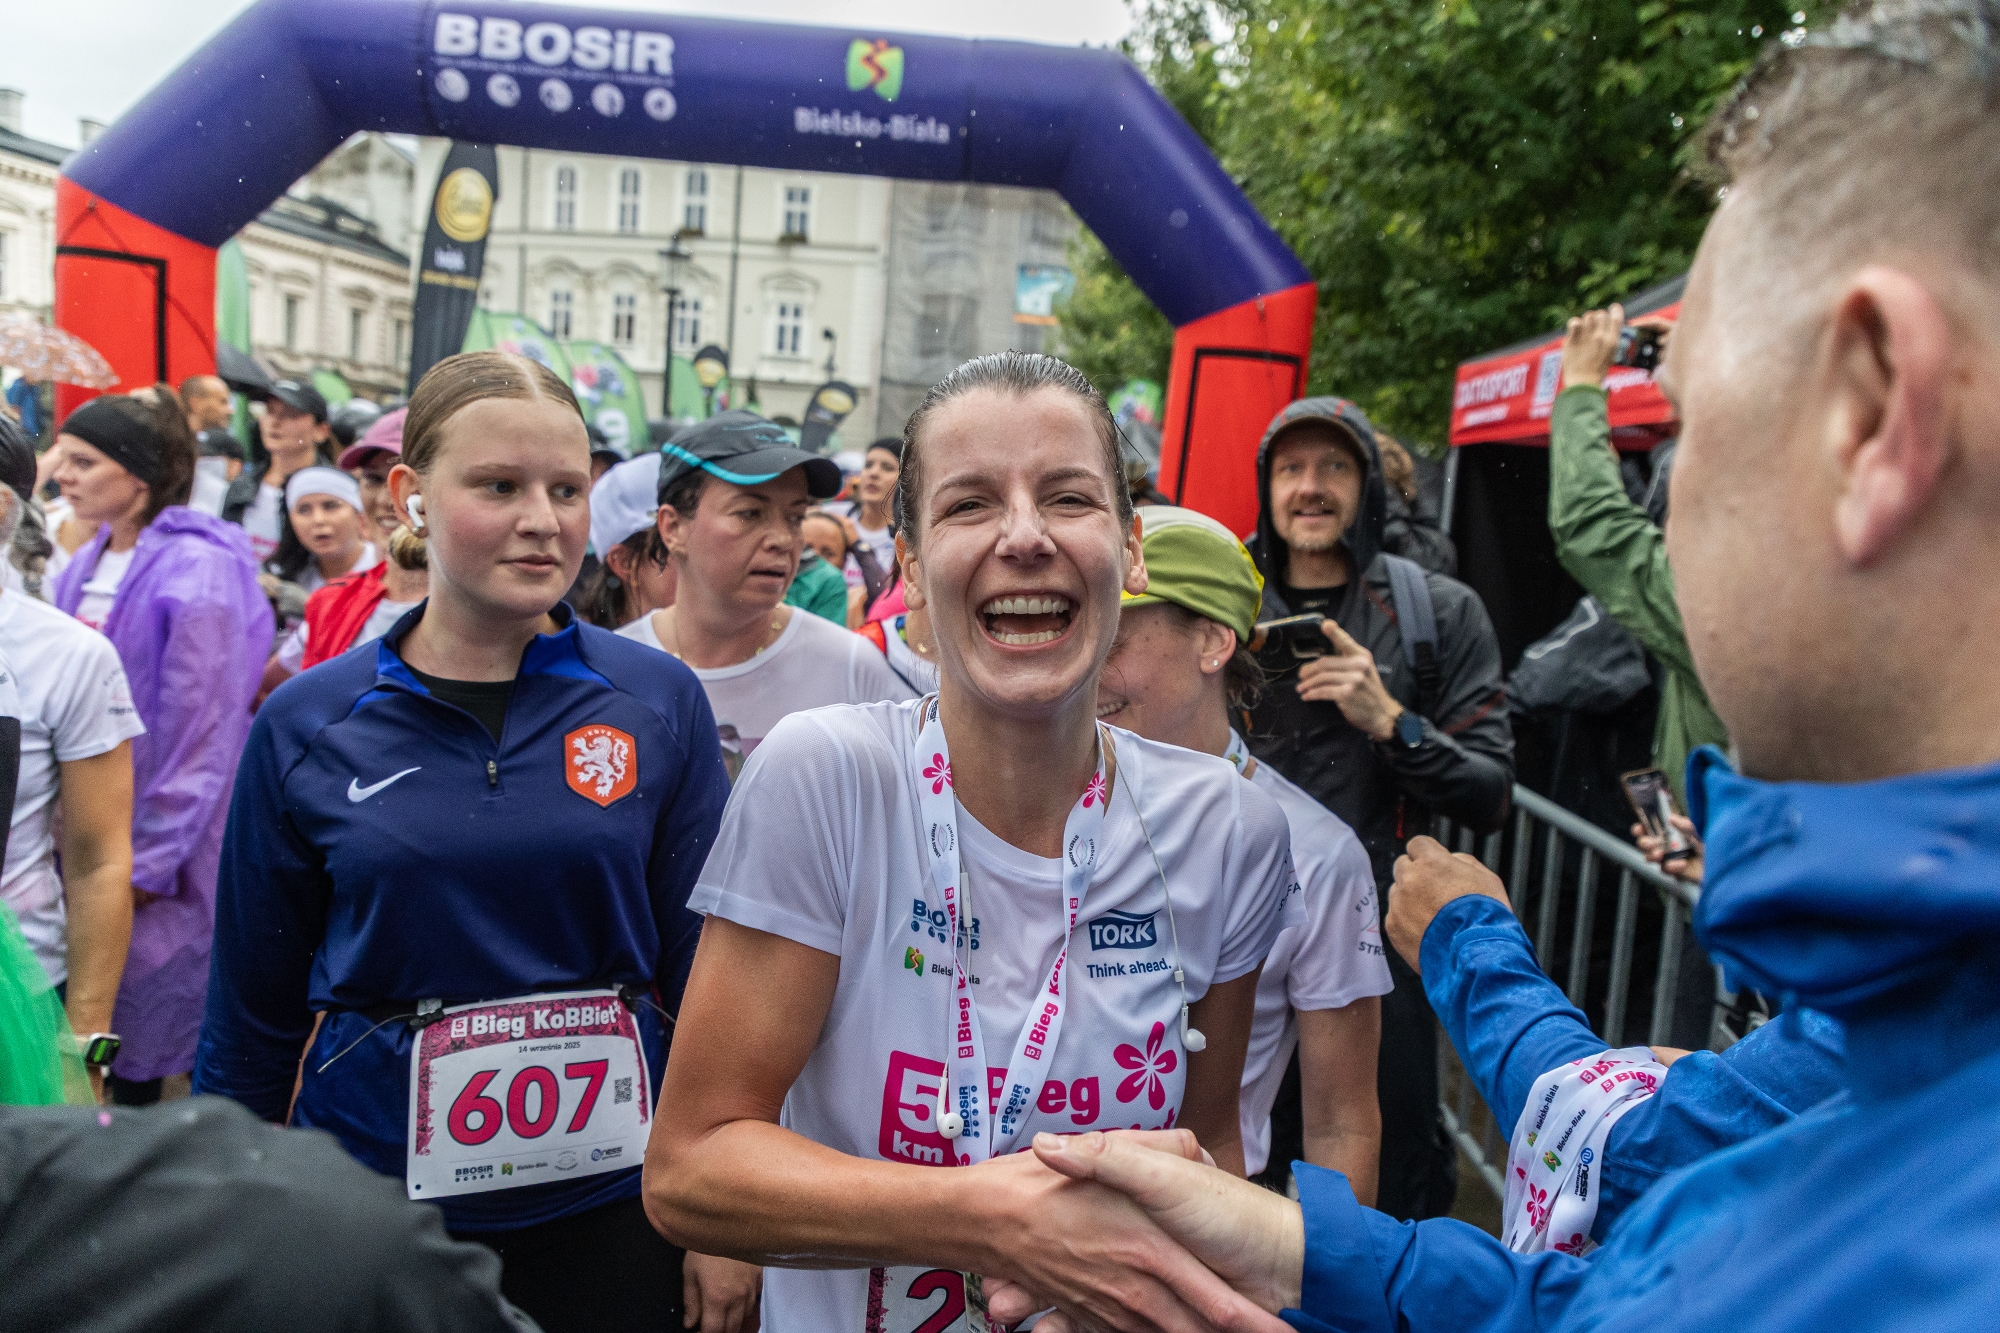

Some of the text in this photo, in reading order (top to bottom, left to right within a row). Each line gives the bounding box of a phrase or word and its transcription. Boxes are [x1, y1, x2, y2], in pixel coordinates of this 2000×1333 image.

[434, 13, 675, 76] BBOSiR
[1091, 921, 1153, 946] TORK
[1087, 957, 1172, 978] Think ahead.
[472, 1005, 617, 1038] Bieg KoBBiet
[957, 997, 972, 1042] Bieg
[1029, 1002, 1059, 1045] Bieg
[518, 1045, 528, 1053] 14
[564, 1042, 581, 1050] 2025
[447, 1058, 610, 1147] 607
[898, 1066, 944, 1134] 5
[1001, 1084, 1022, 1134] BBOSiR
[893, 1130, 944, 1164] km
[455, 1165, 494, 1176] BBOSiR
